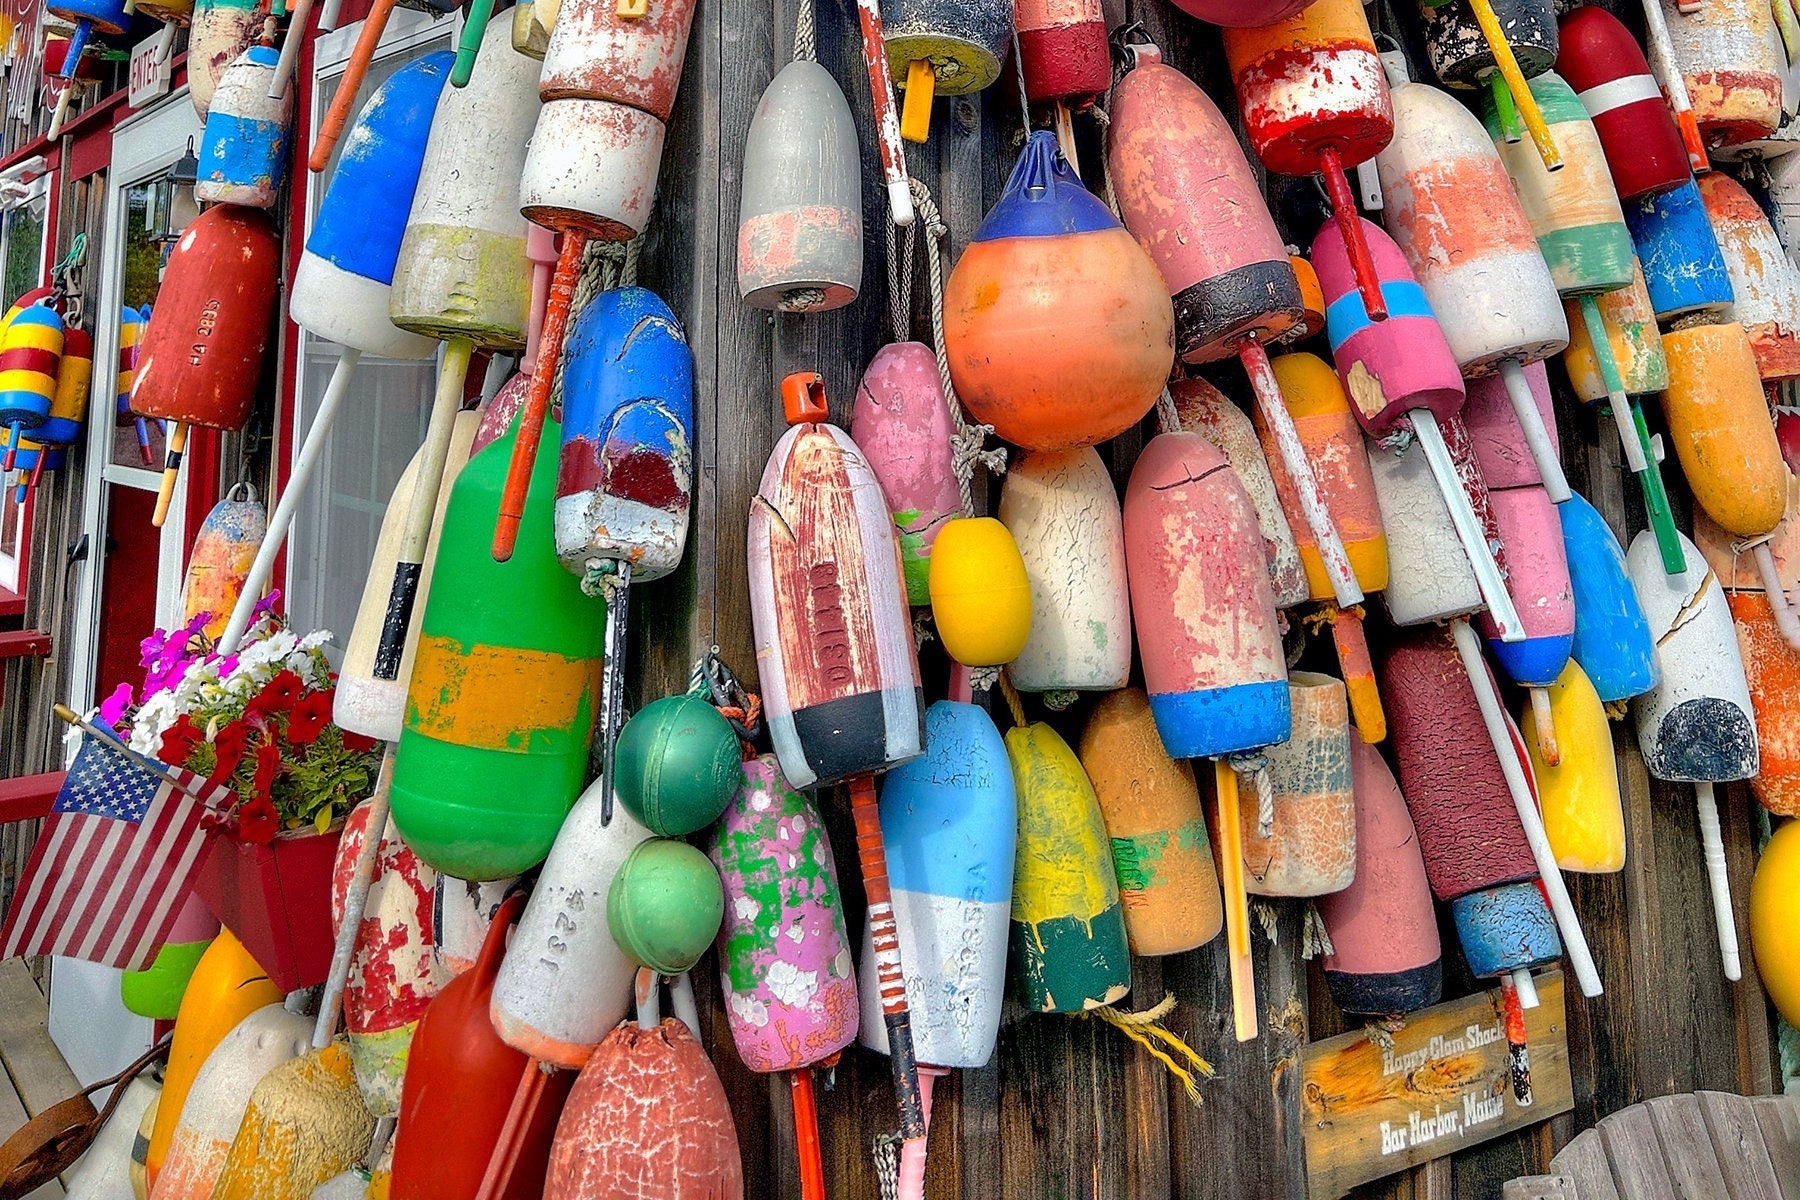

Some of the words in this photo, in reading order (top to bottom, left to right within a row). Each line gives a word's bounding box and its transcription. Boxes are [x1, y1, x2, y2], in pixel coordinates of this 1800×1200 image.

[131, 44, 159, 95] ENTER
[1383, 1046, 1428, 1076] Happy
[1430, 1036, 1464, 1057] Clam
[1466, 1021, 1506, 1050] Shack
[1380, 1120, 1406, 1155] Bar
[1408, 1105, 1464, 1146] Harbor,
[1464, 1090, 1504, 1126] Maine
